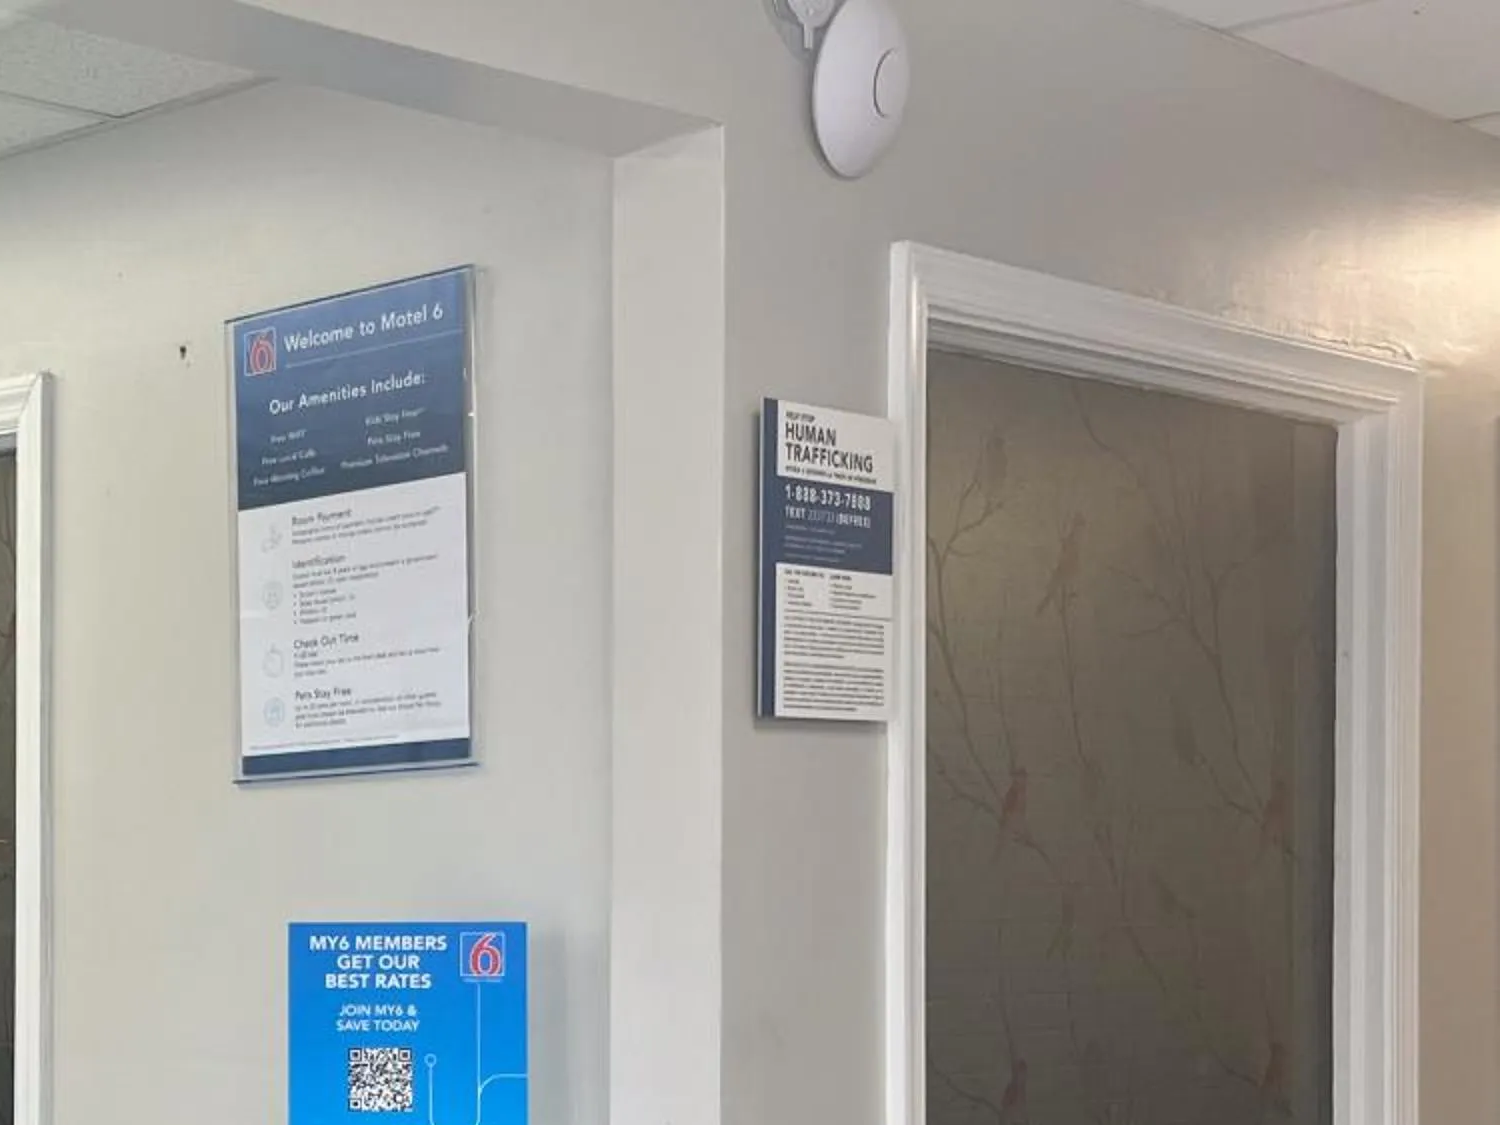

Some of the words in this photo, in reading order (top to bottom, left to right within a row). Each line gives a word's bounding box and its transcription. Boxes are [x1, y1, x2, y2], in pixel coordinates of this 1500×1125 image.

[283, 326, 354, 352] Welcome
[359, 320, 375, 337] to
[381, 304, 428, 331] Motel
[432, 303, 444, 320] 6
[268, 399, 294, 415] Our
[299, 384, 367, 409] Amenities
[371, 370, 425, 392] Include:
[785, 421, 837, 447] HUMAN
[785, 441, 874, 474] TRAFFICKING
[309, 935, 350, 951] MY6
[355, 935, 447, 951] MEMBERS
[337, 954, 374, 970] GET
[378, 954, 421, 970] OUR
[469, 932, 503, 977] 6
[325, 973, 368, 989] BEST
[374, 973, 432, 989] RATES
[339, 1004, 371, 1017] JOIN
[374, 1004, 403, 1017] MY6
[406, 1004, 417, 1017] &
[336, 1019, 370, 1032] SAVE
[374, 1019, 420, 1032] TODAY
